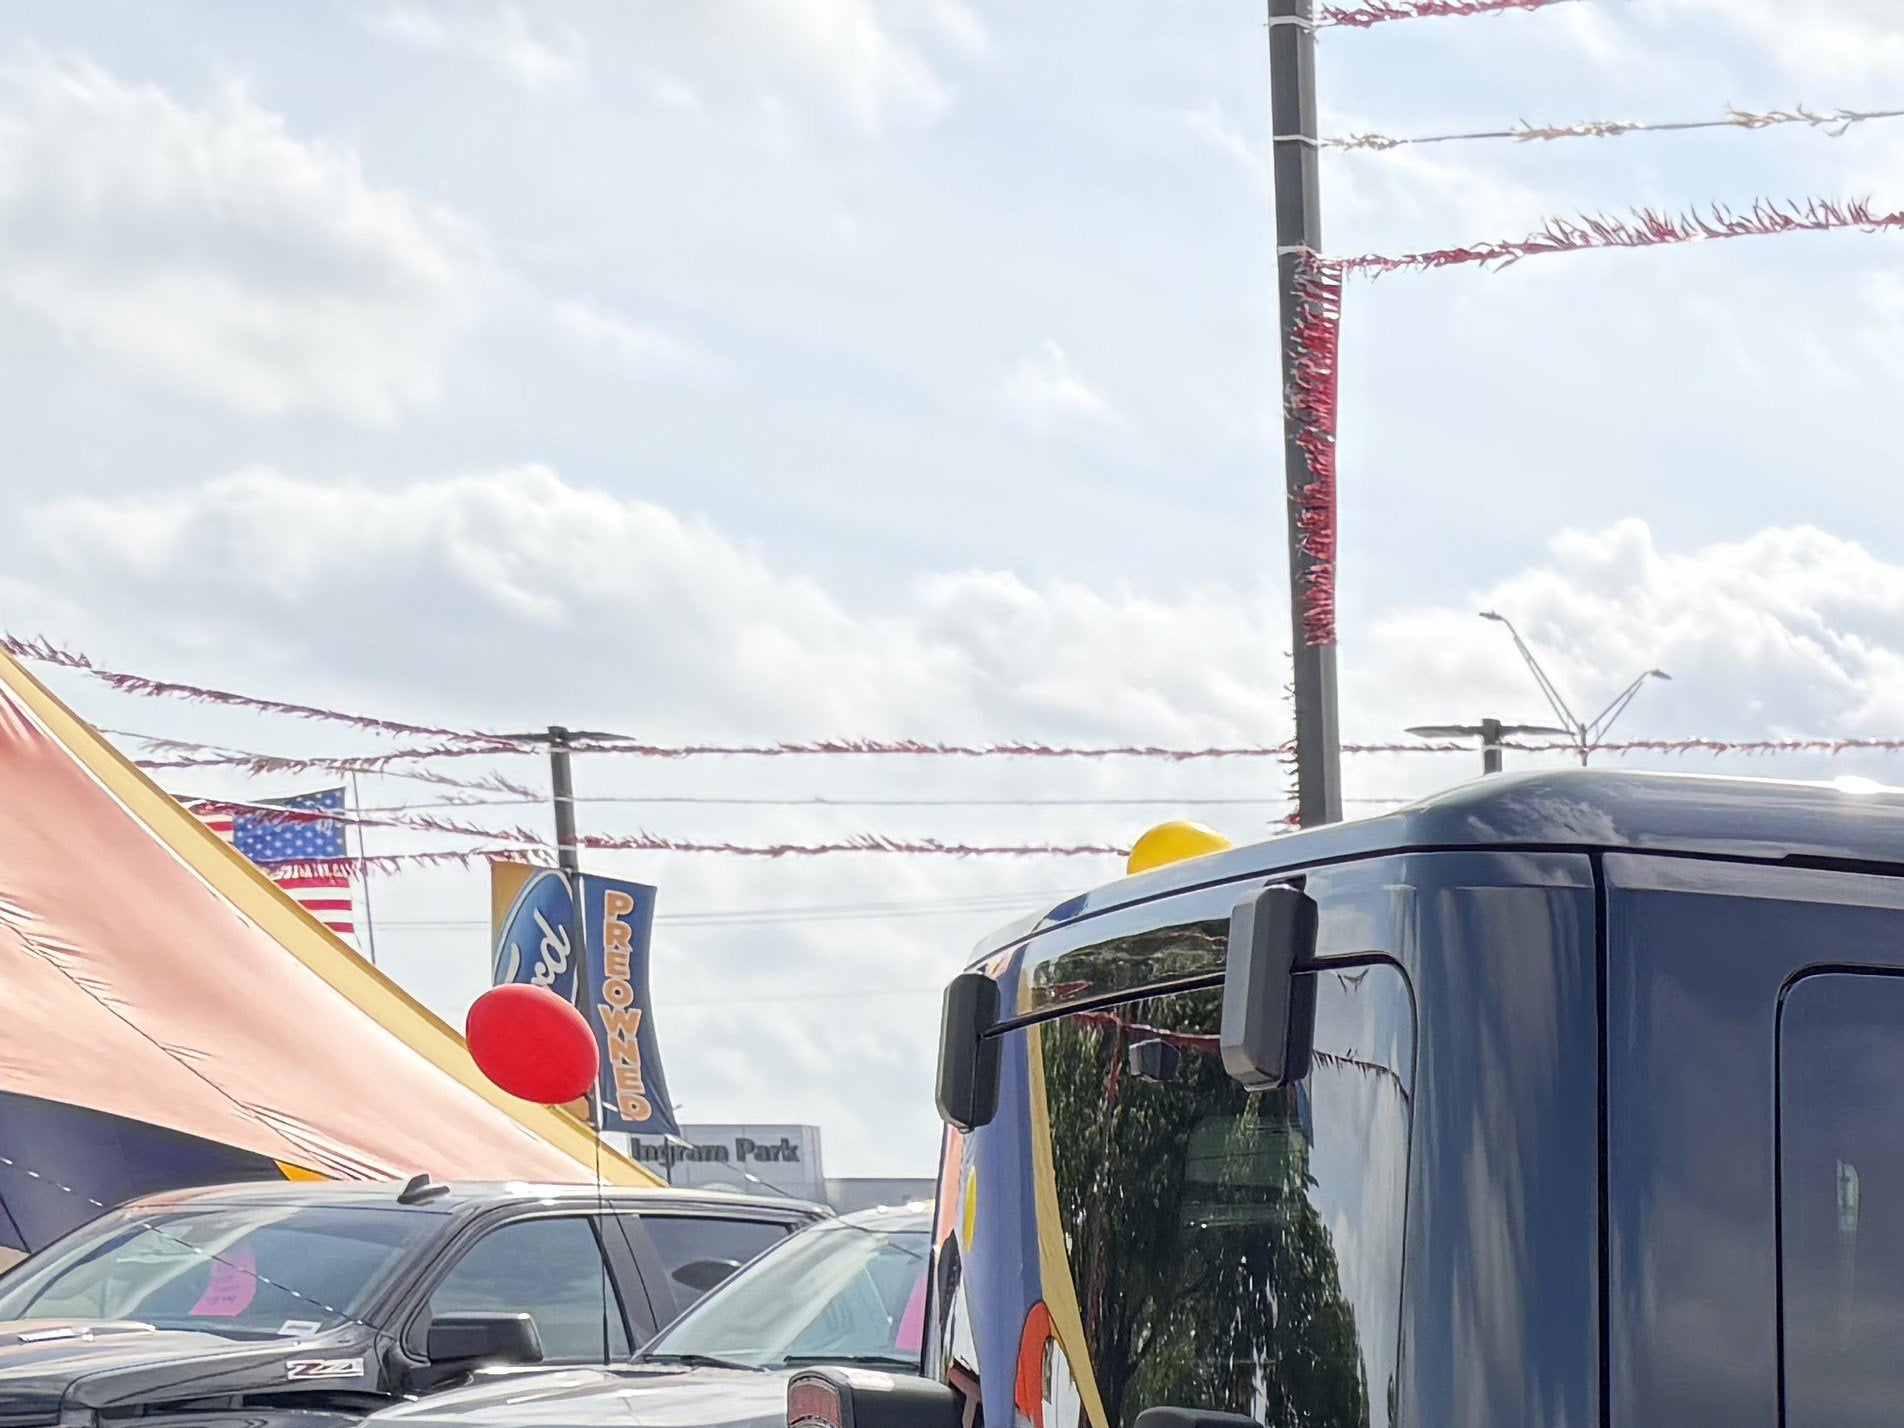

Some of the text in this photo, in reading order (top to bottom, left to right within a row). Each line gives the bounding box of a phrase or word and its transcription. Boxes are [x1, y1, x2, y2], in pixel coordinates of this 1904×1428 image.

[597, 889, 653, 1122] PREOWNED
[631, 1137, 800, 1168] Ingram Park
